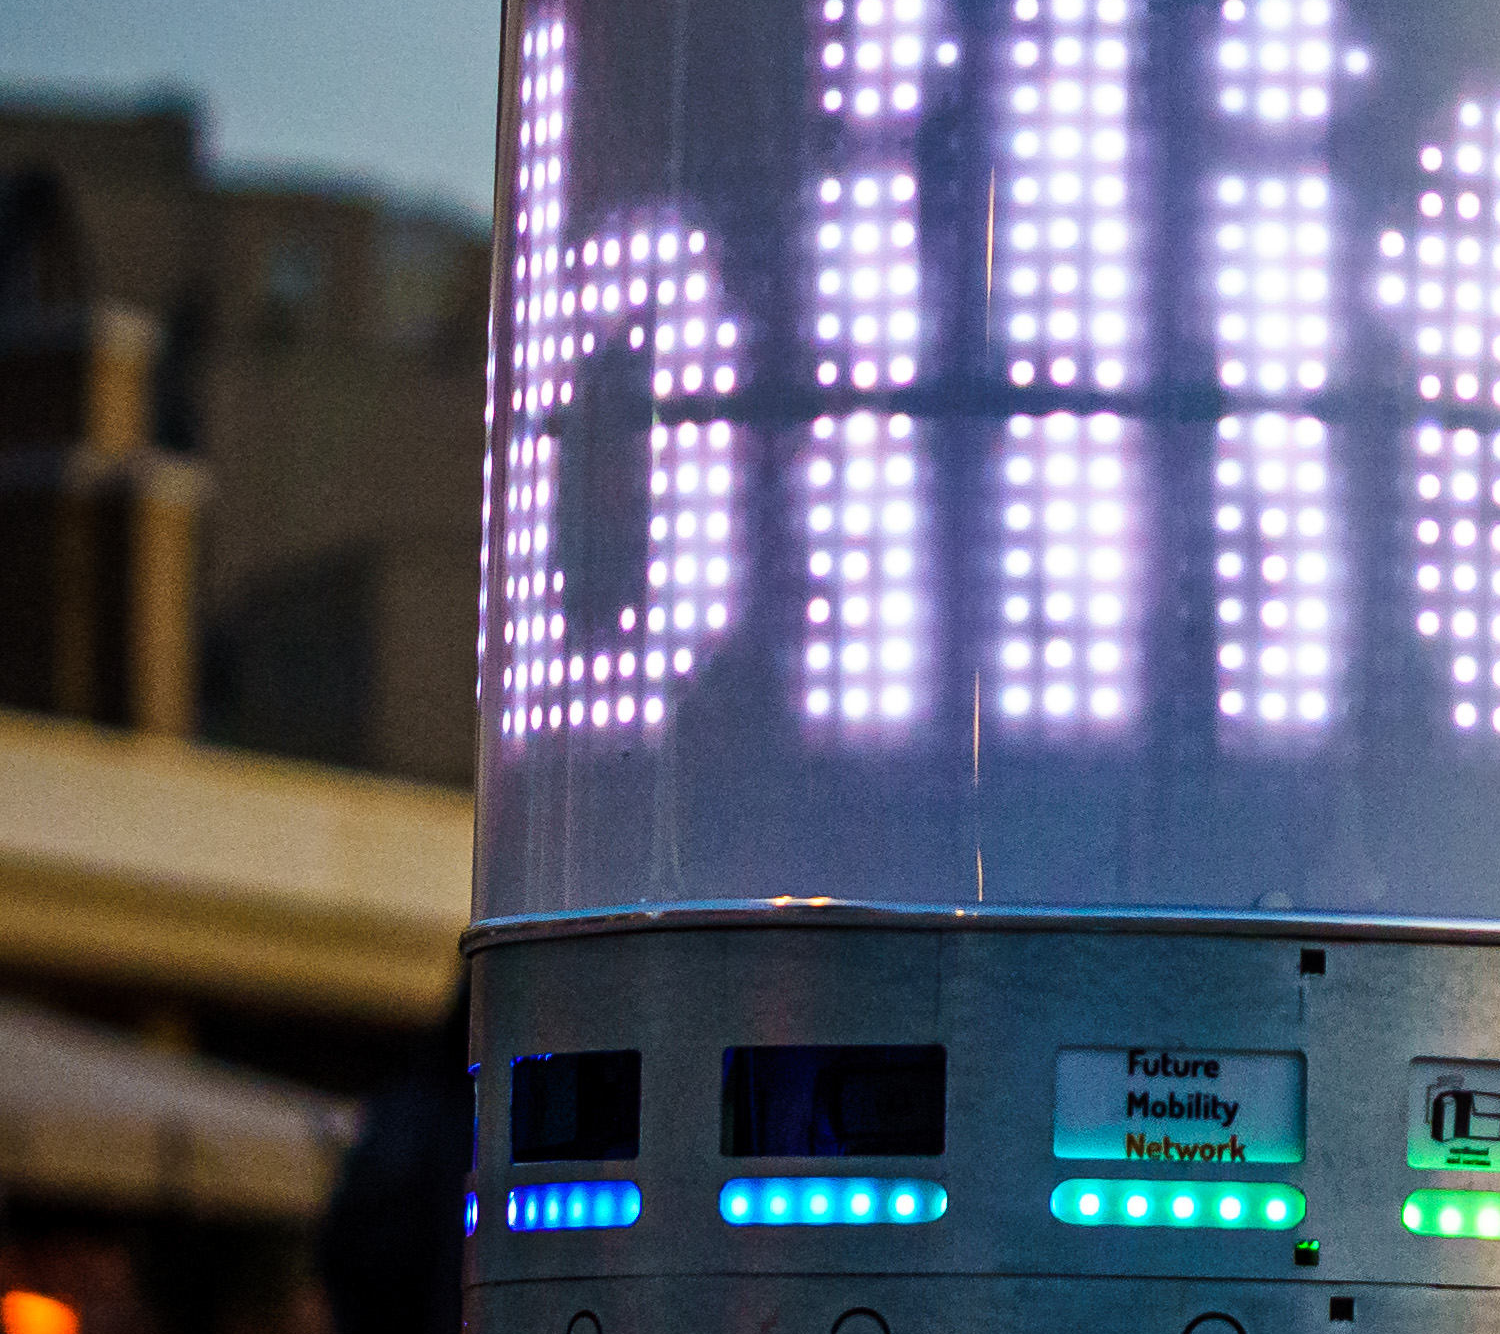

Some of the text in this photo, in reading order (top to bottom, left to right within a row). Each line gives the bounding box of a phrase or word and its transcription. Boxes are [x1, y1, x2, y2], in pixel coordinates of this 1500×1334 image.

[1127, 1047, 1221, 1079] Future
[1126, 1090, 1239, 1128] Mobility
[1125, 1132, 1246, 1162] Network
